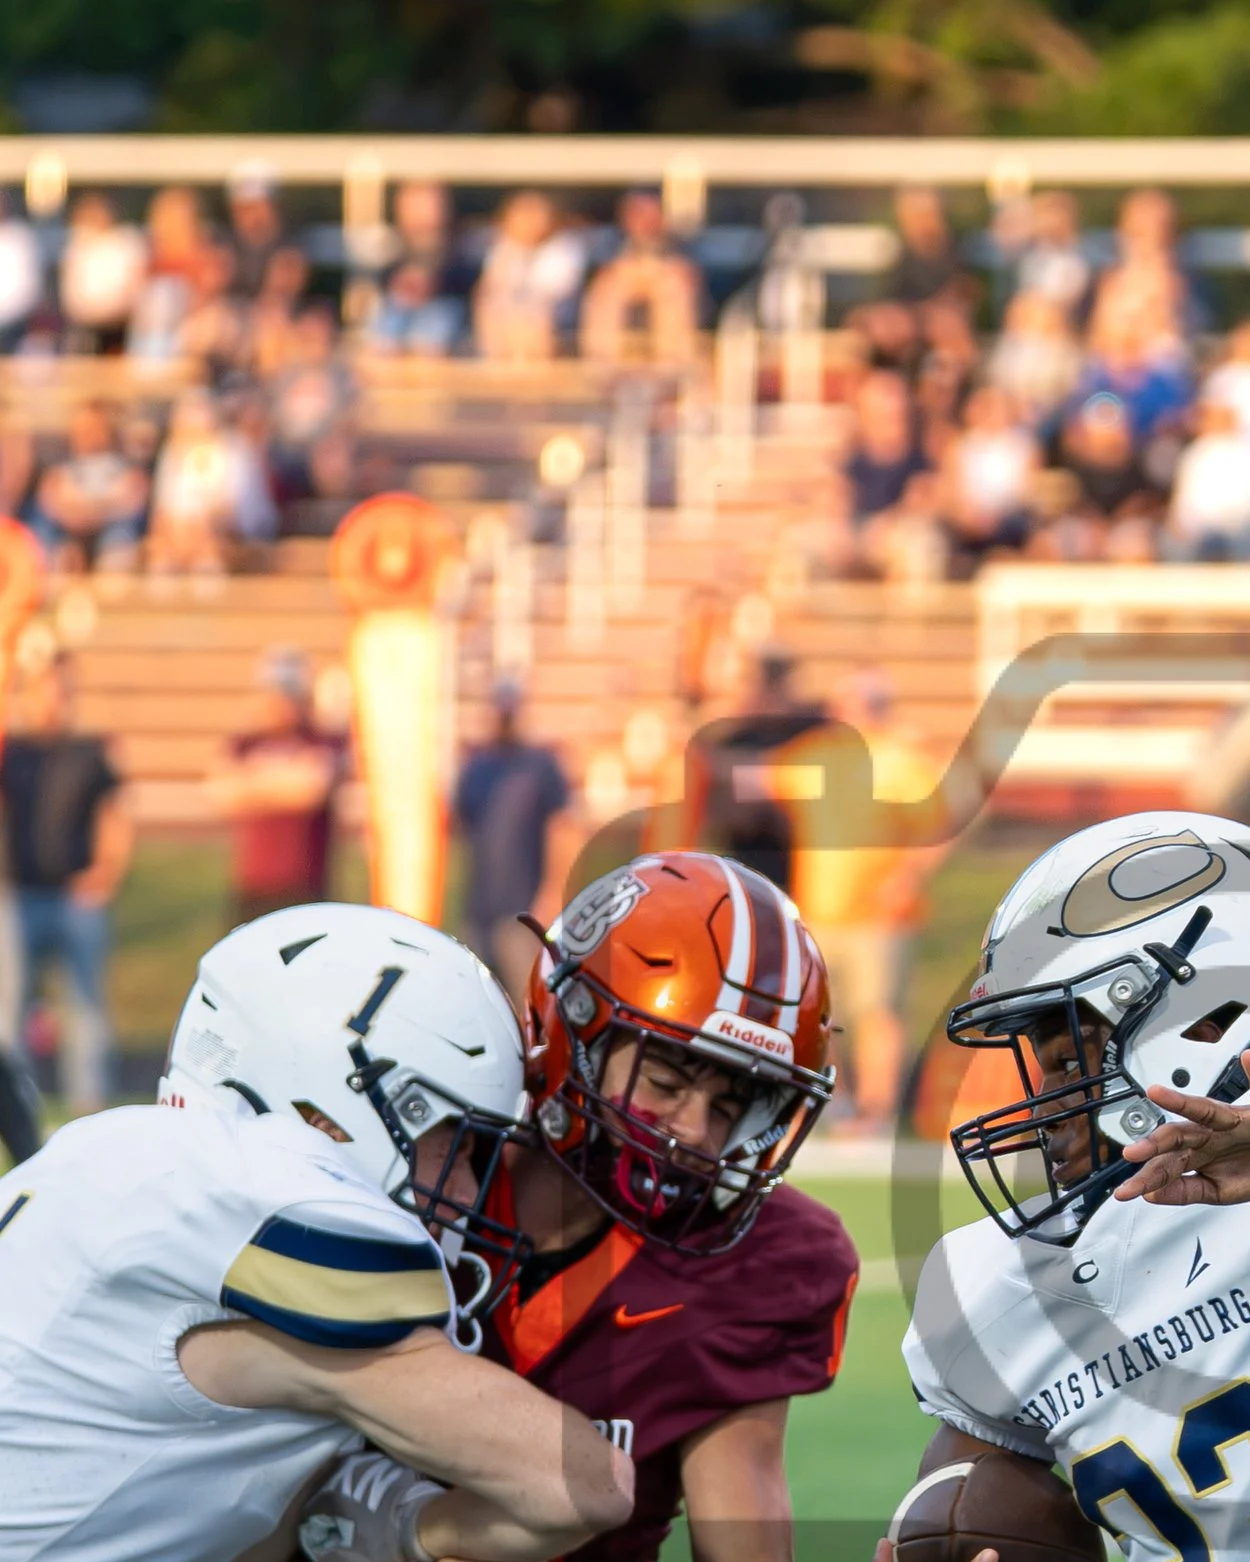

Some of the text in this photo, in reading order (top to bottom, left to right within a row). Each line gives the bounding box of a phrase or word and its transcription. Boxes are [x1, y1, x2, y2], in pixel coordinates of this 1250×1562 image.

[344, 965, 406, 1038] 1
[718, 1019, 788, 1056] Riddell
[1071, 1259, 1100, 1285] C
